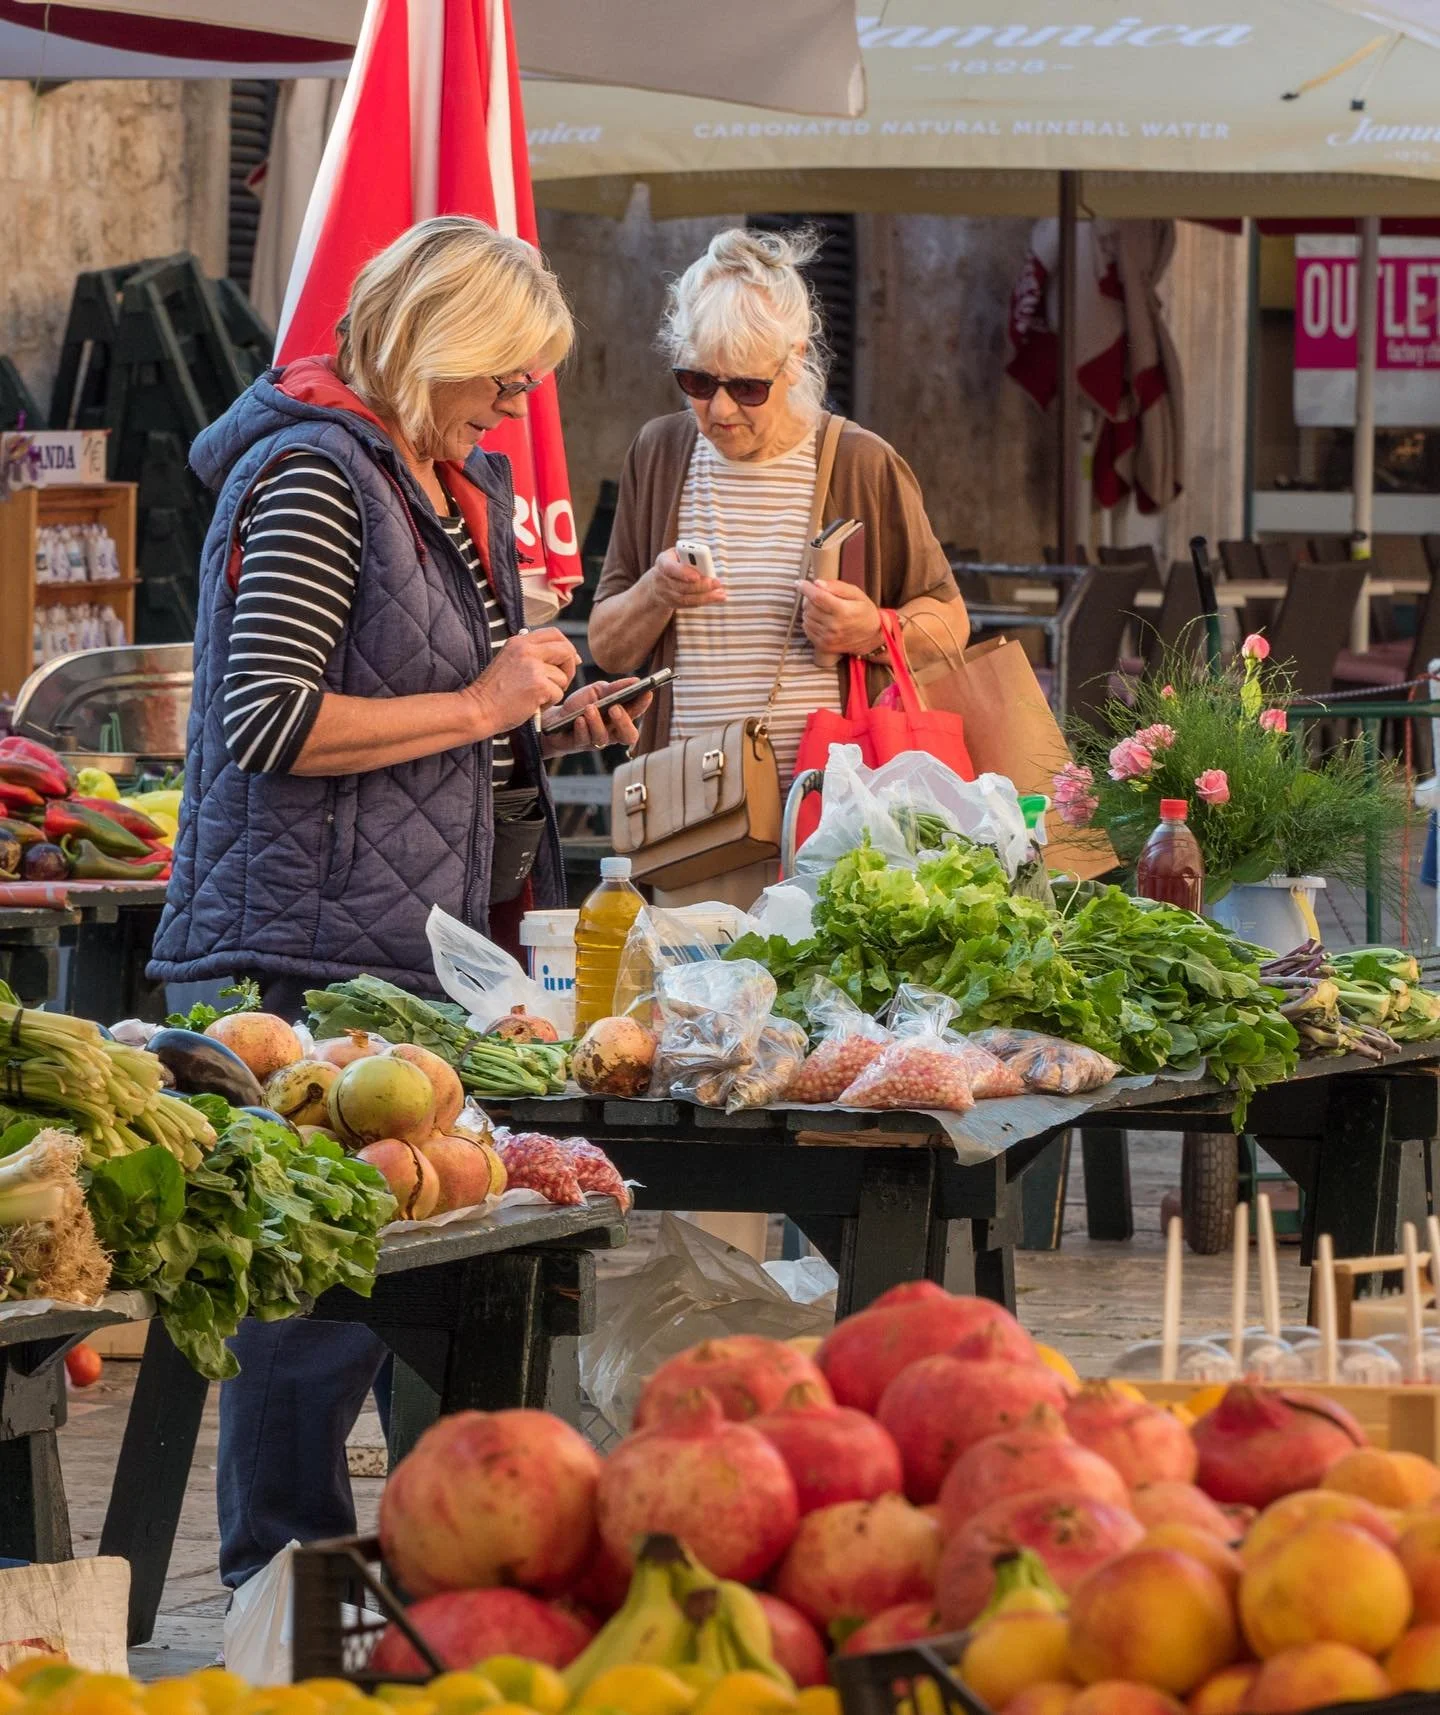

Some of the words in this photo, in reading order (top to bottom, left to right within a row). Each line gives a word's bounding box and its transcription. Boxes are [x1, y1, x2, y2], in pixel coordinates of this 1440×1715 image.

[693, 120, 870, 139] CARBONATED
[880, 120, 1000, 135] NATURAL
[1012, 120, 1130, 137] MINERAL
[1141, 122, 1230, 139] WATER
[1302, 263, 1440, 338] OULE
